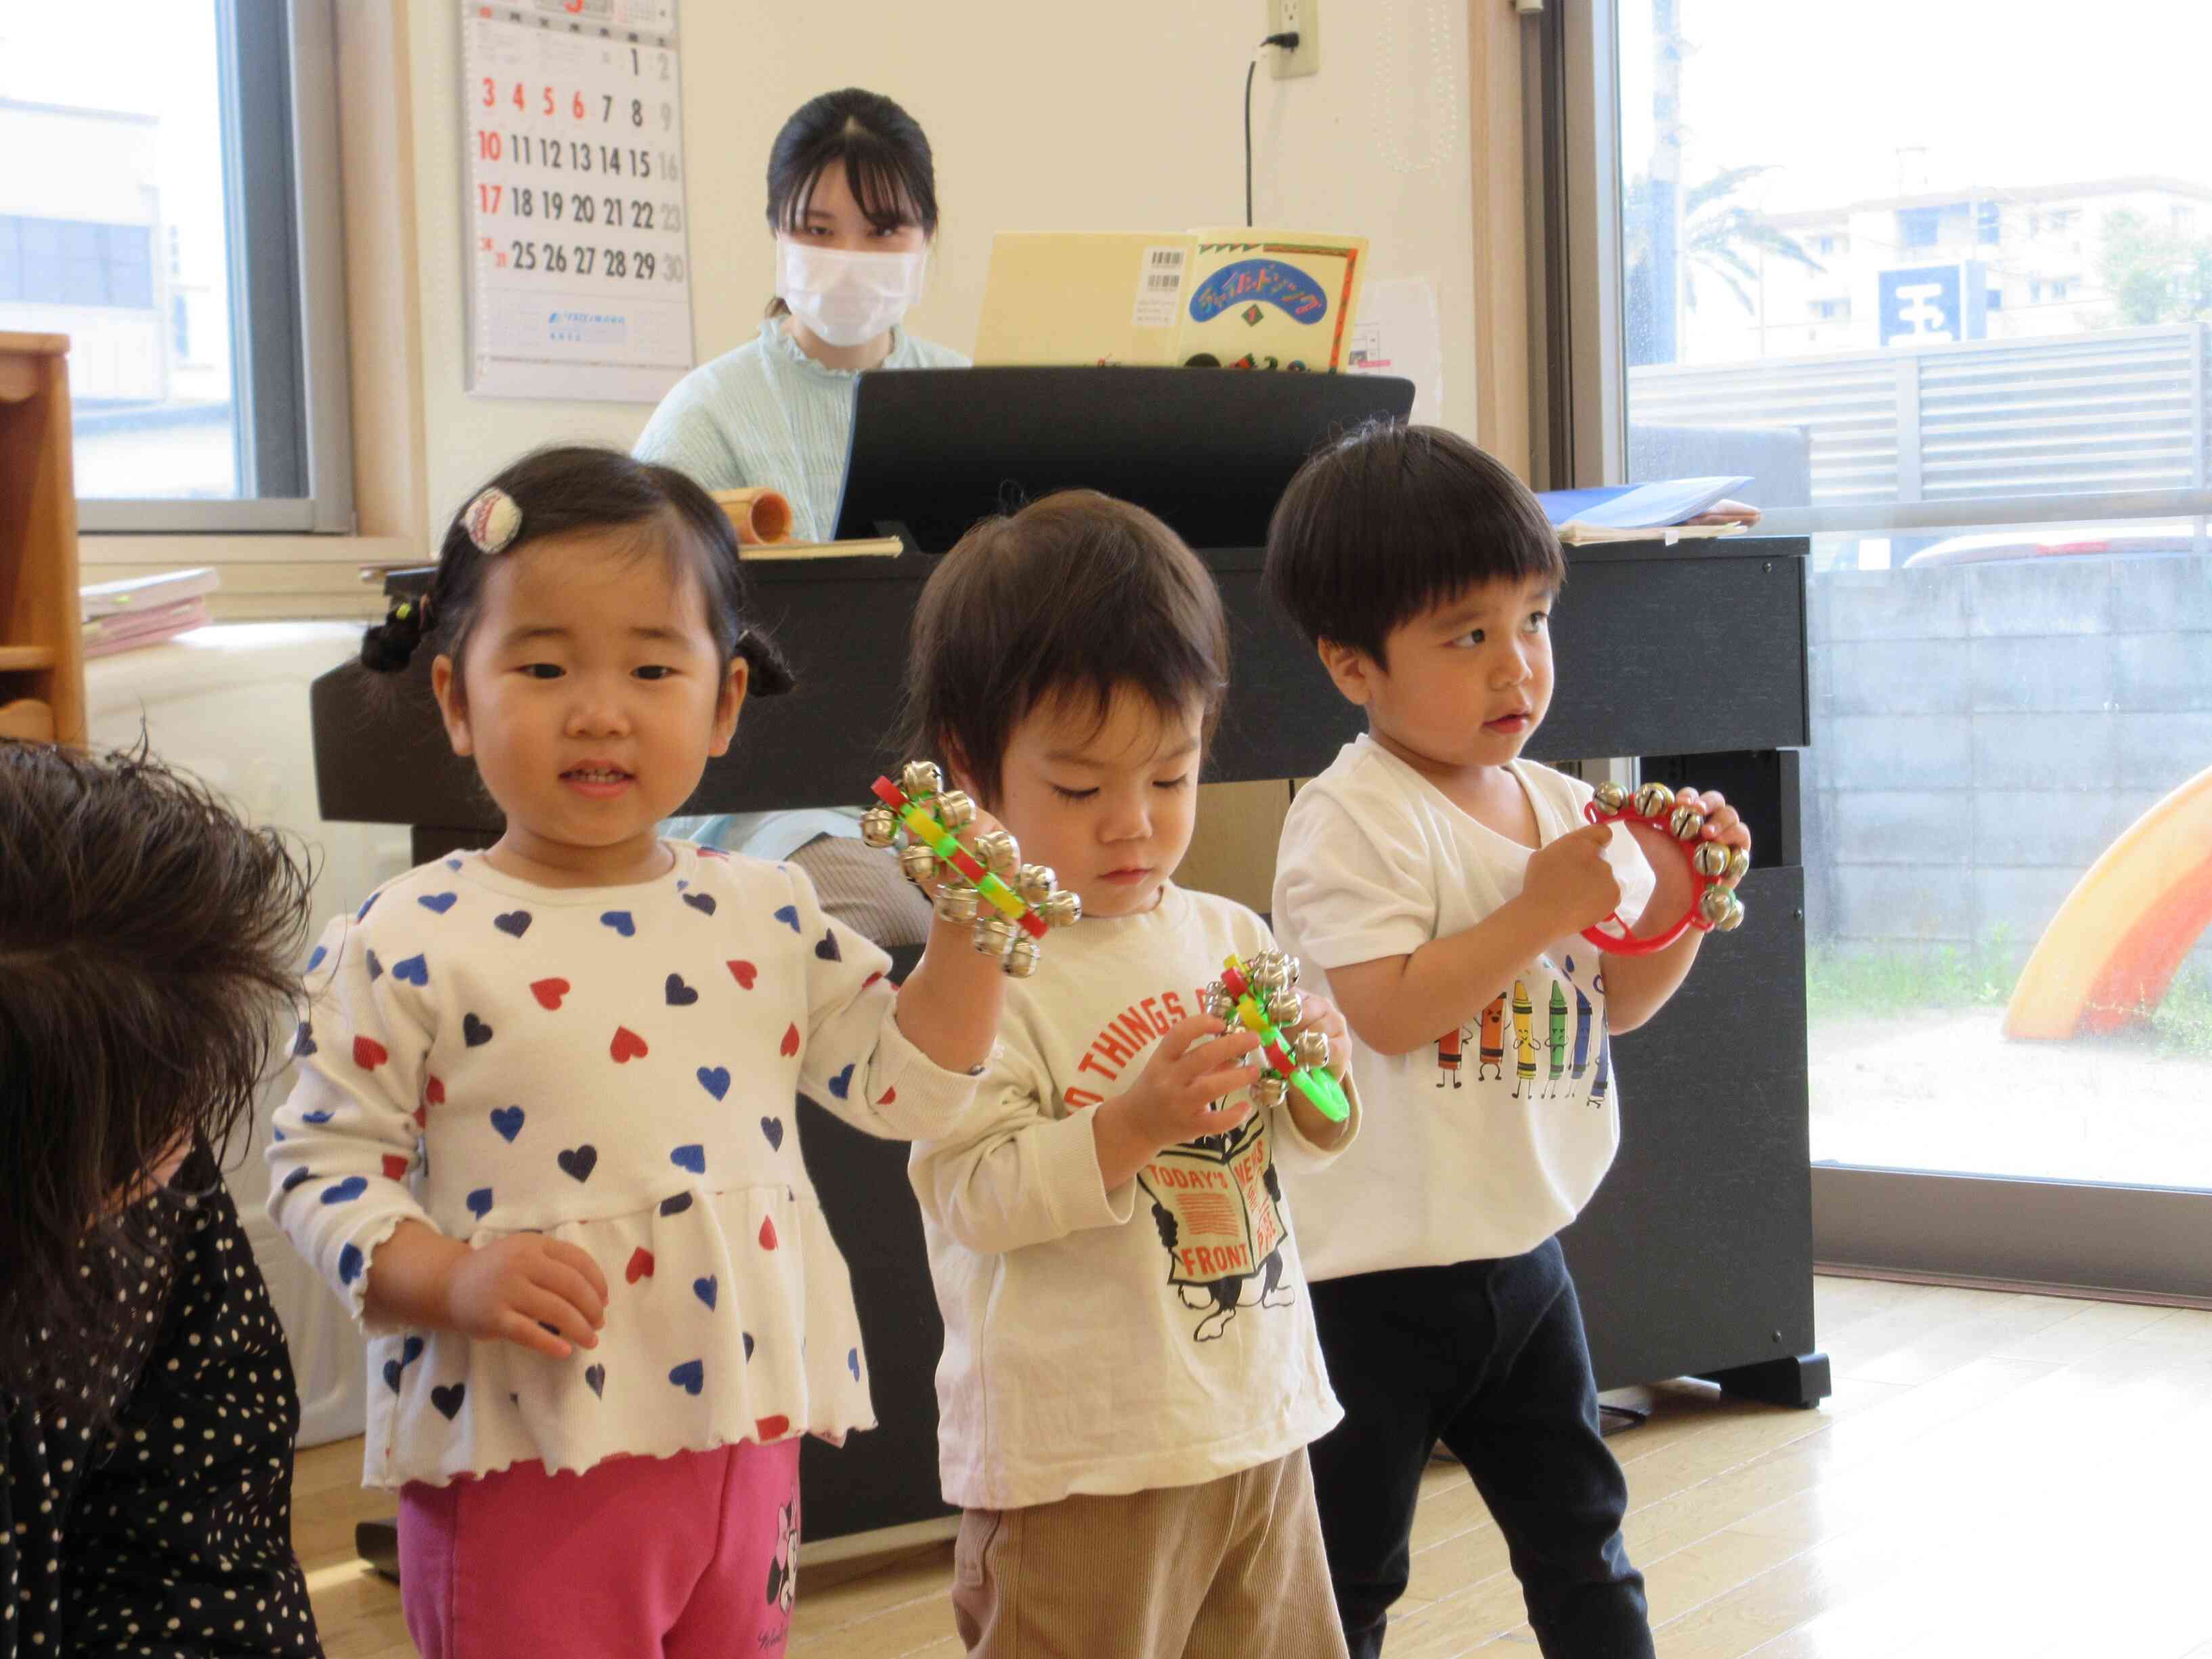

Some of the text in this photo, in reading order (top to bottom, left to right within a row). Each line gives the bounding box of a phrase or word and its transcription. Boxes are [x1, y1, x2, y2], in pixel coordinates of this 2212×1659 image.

[631, 47, 638, 76] 1
[483, 77, 496, 107] 3
[513, 84, 525, 111] 4
[544, 87, 556, 116] 5
[573, 92, 585, 119] 6
[603, 95, 613, 122] 7
[632, 100, 643, 127] 8
[479, 131, 502, 161] 10
[511, 134, 531, 165] 11
[540, 139, 561, 169] 12
[571, 142, 591, 171] 13
[601, 146, 621, 175] 14
[630, 150, 650, 178] 15
[479, 184, 502, 214] 17
[513, 188, 533, 217] 18
[543, 192, 563, 219] 19
[572, 194, 594, 223] 20
[604, 198, 622, 225] 21
[632, 200, 653, 230] 22
[513, 241, 537, 270] 25
[544, 244, 567, 272] 26
[574, 246, 596, 274] 27
[604, 249, 626, 278] 28
[634, 252, 655, 279] 29
[1078, 991, 1186, 1081] THINGS
[1150, 1164, 1228, 1189] TODAY'S
[1180, 1243, 1247, 1277] FRONT
